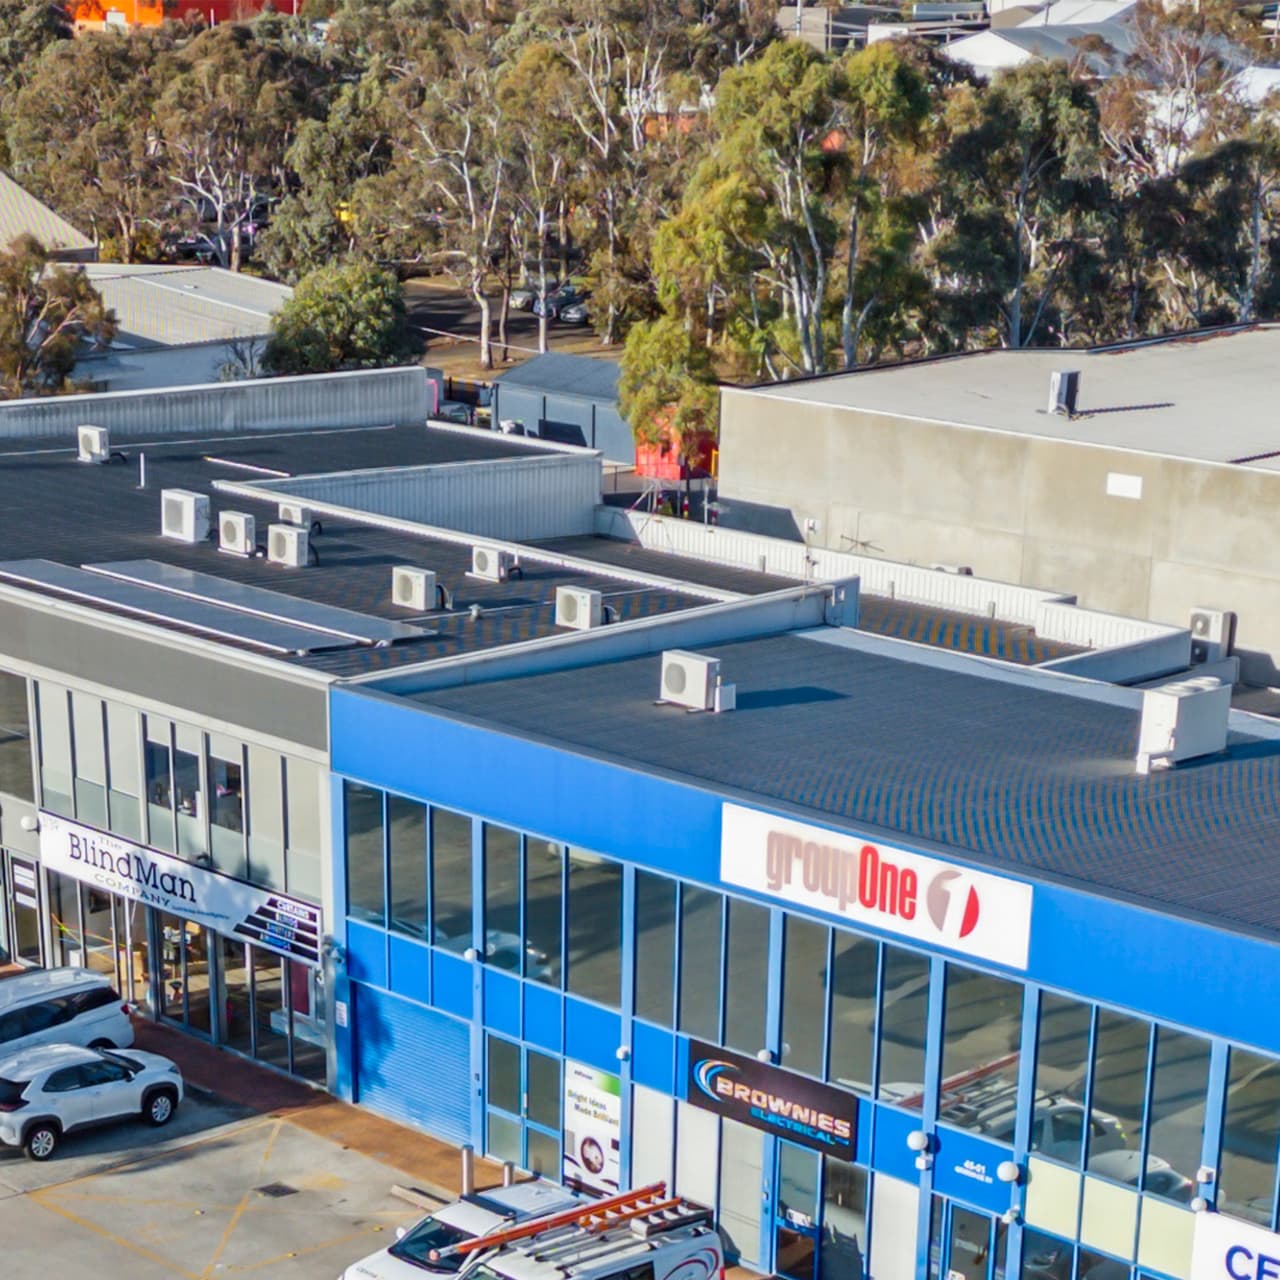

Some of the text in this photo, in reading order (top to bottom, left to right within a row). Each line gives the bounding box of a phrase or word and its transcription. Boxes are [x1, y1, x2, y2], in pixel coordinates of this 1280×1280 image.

[69, 832, 198, 903] BlindMan
[94, 872, 170, 907] COMPANY
[766, 830, 918, 921] groupOne
[716, 1077, 851, 1138] BROWNIES
[749, 1107, 836, 1145] ELECTRICAL
